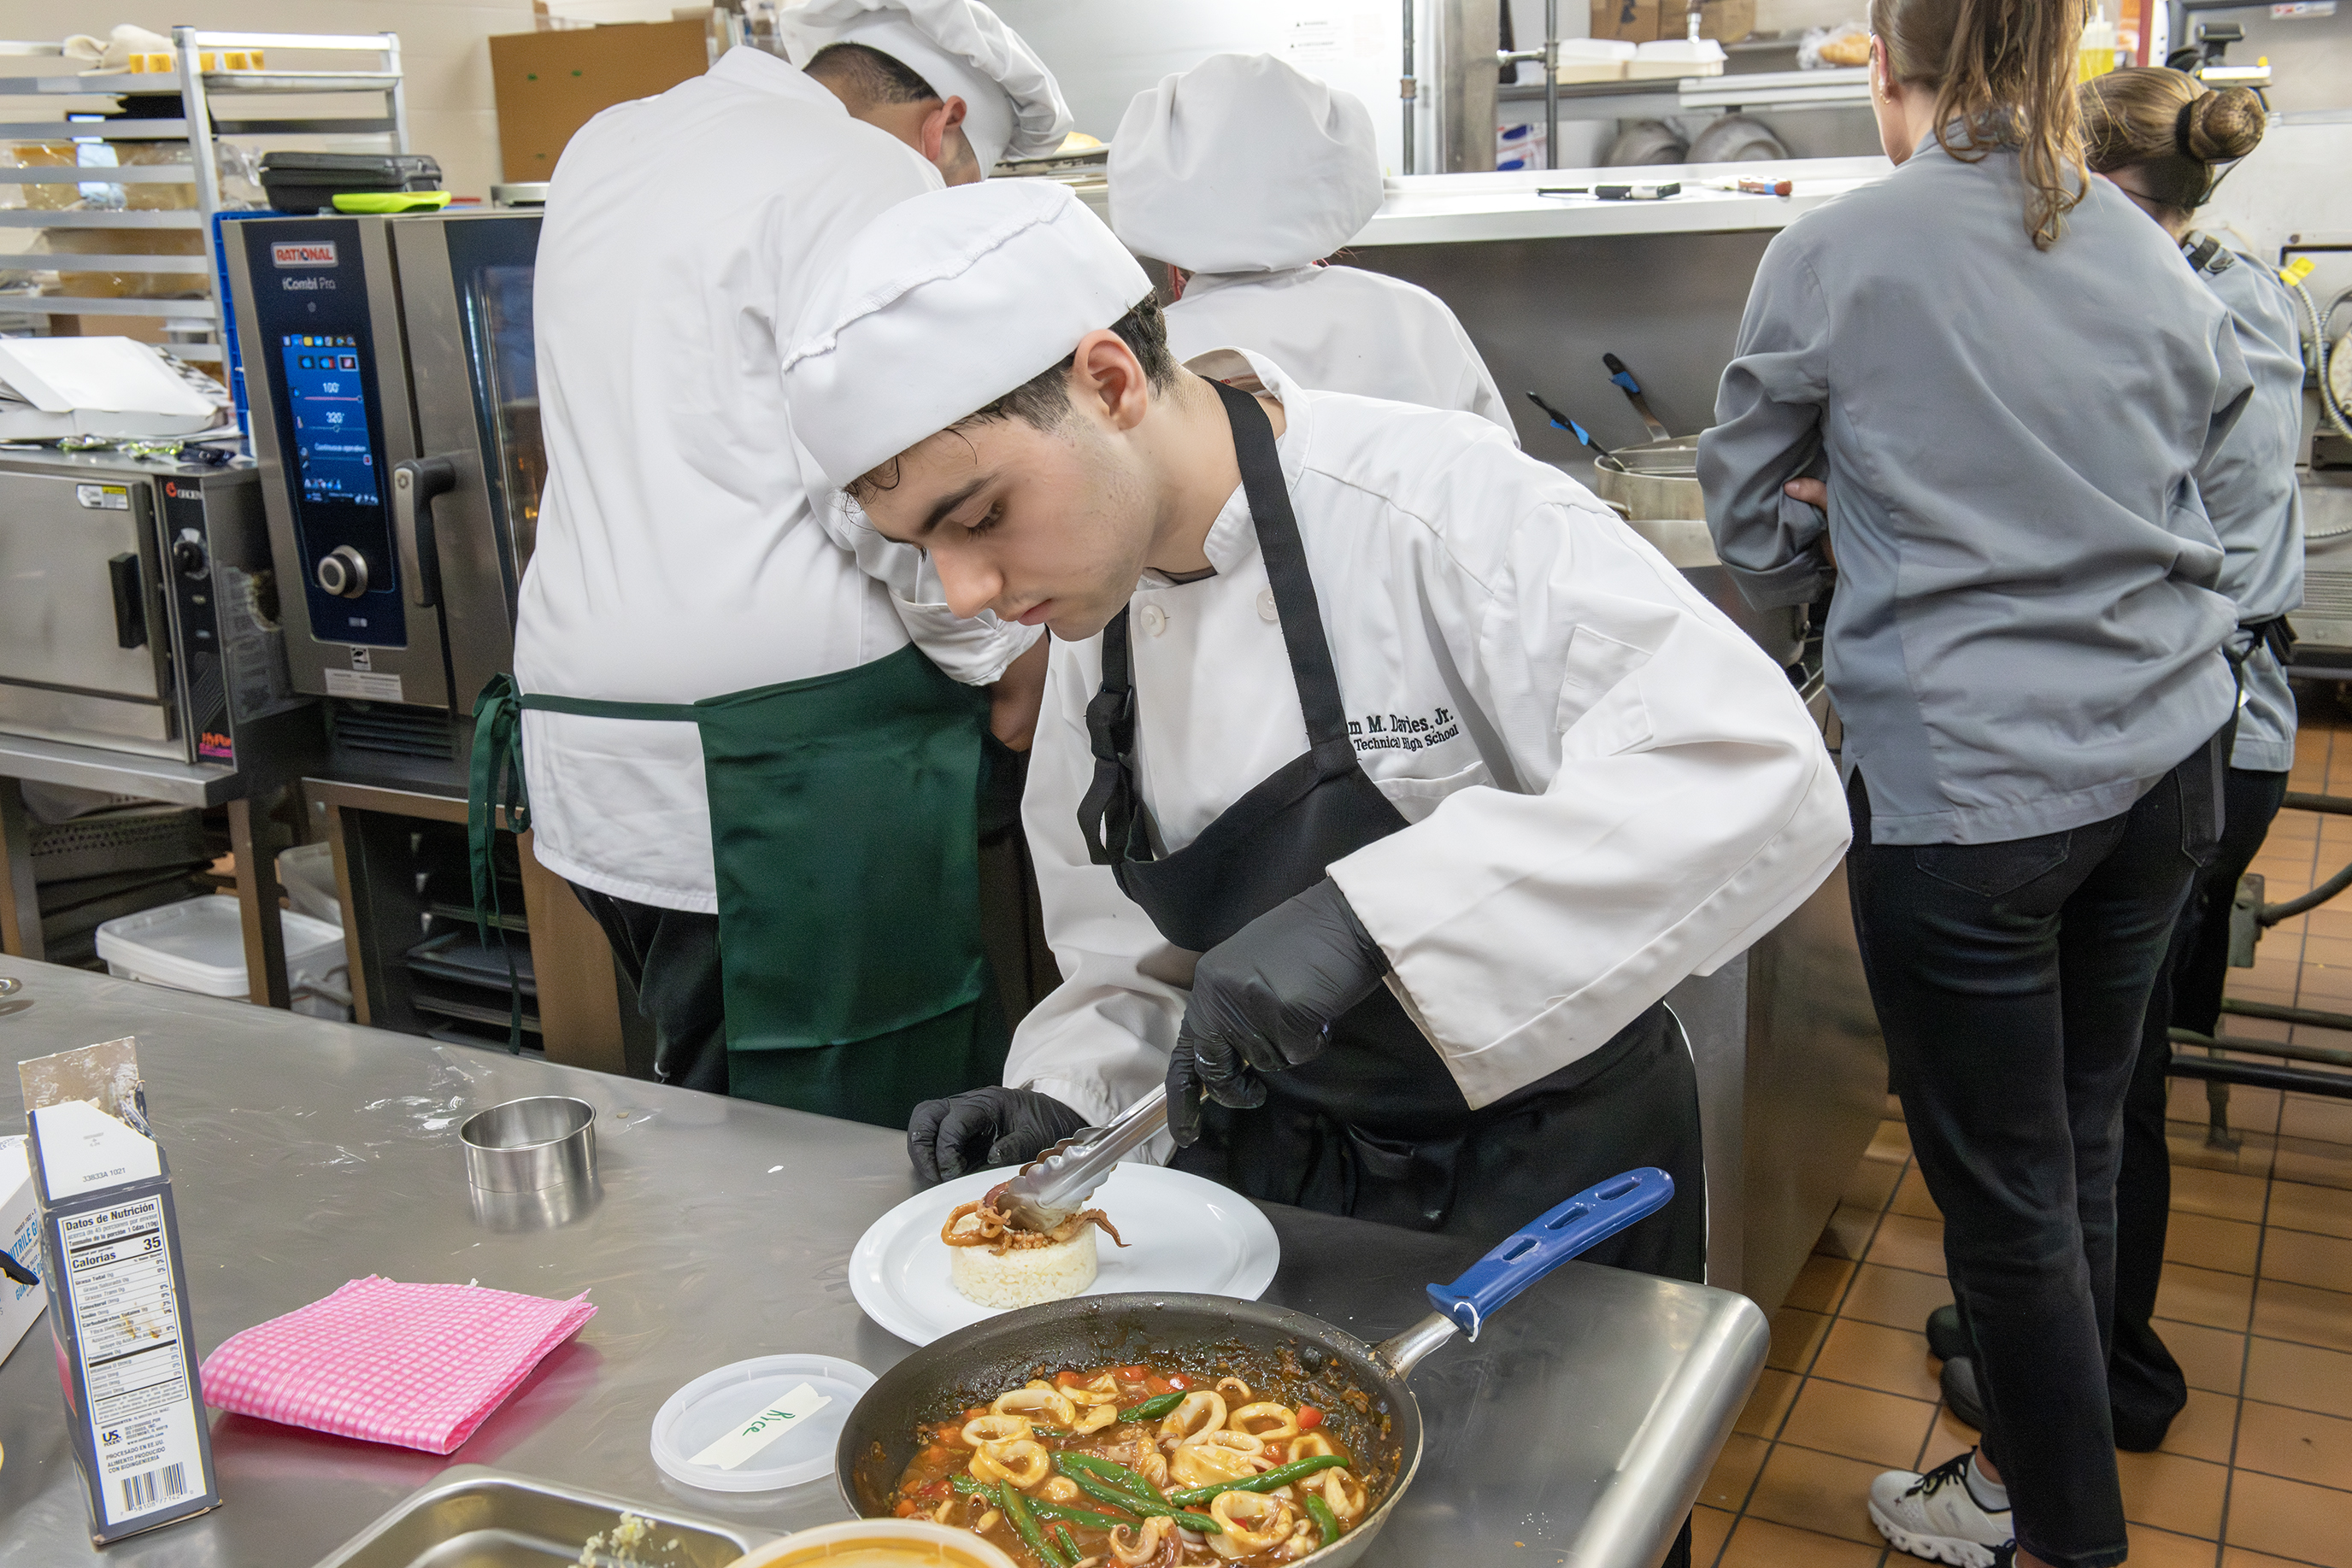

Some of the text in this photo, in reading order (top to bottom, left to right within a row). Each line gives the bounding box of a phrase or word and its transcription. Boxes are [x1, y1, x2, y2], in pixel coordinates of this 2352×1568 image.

[275, 248, 333, 261] RATIONAL
[282, 277, 336, 291] iCombi Pro
[1366, 714, 1388, 733] M.
[1435, 707, 1454, 725] Jr.
[1354, 725, 1460, 752] Technical High School
[82, 1167, 126, 1183] 33833A 1021
[66, 1203, 155, 1230] Datos de Nutrición
[144, 1236, 161, 1250] 35
[106, 1447, 138, 1460] PROCESADO
[108, 1446, 166, 1467] ALIMENTO PRODUCIDO
